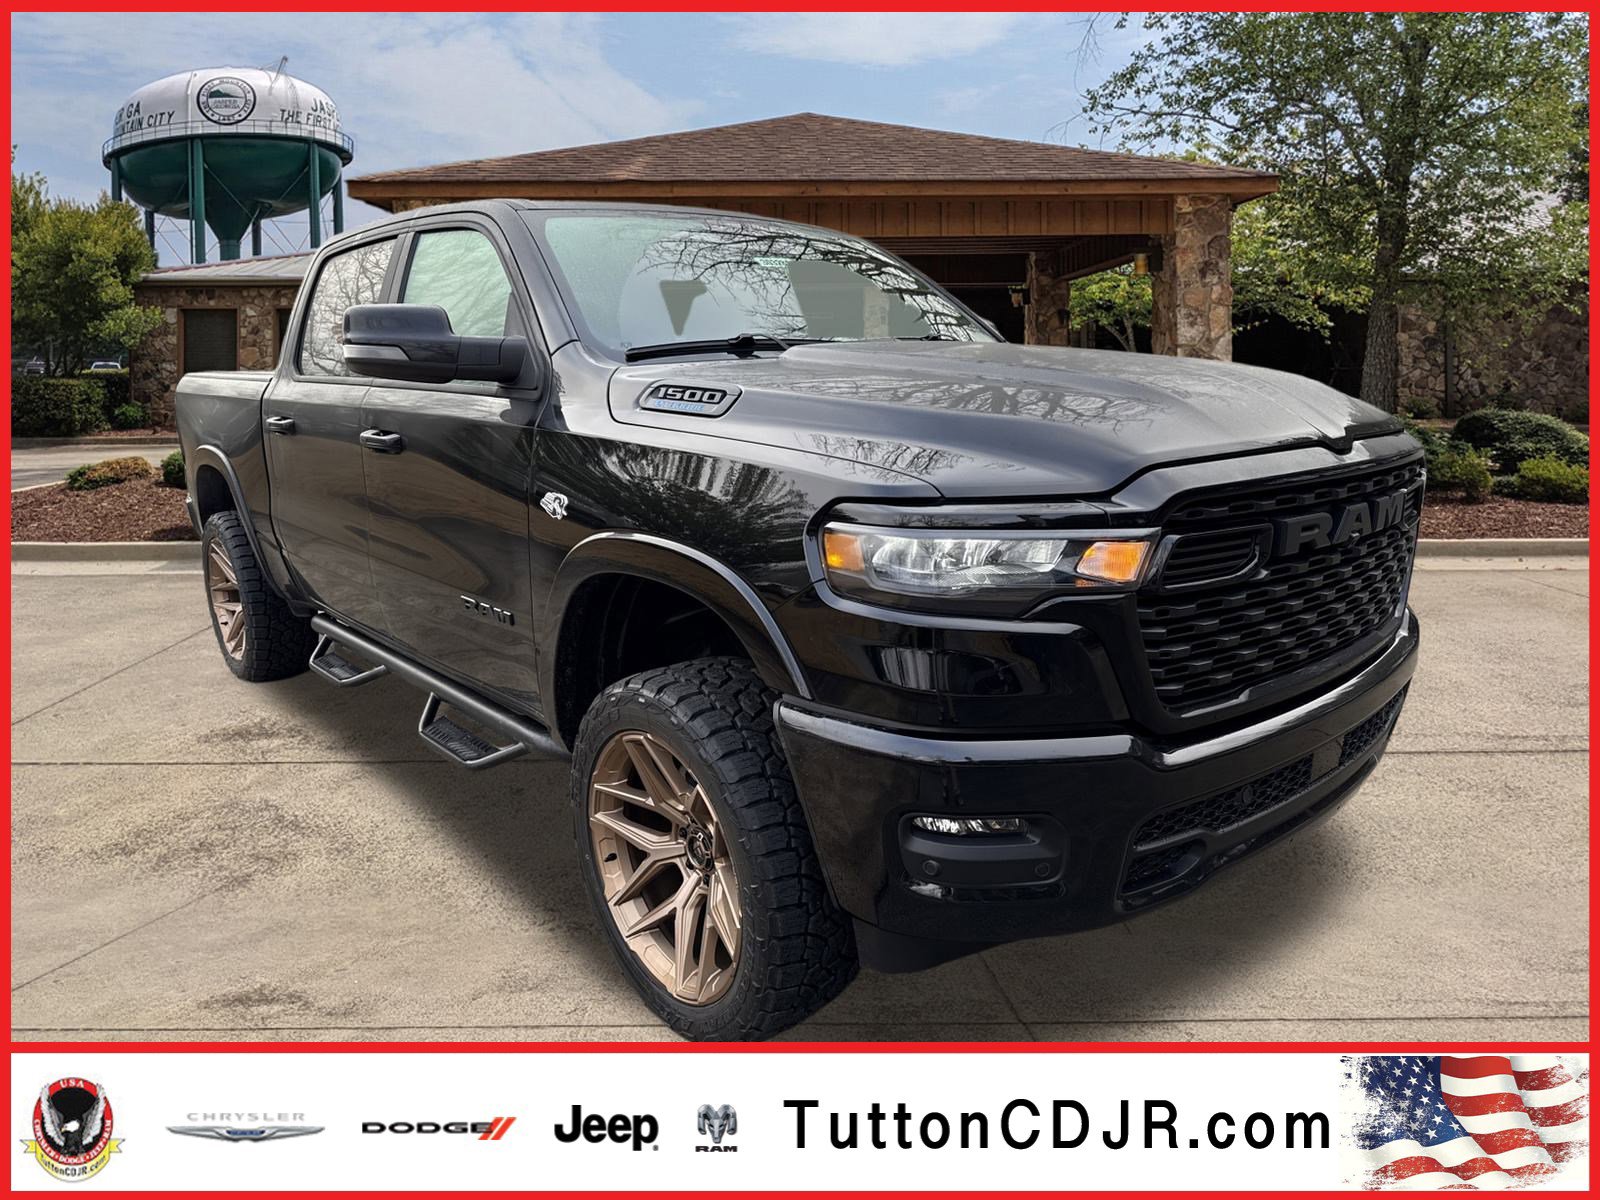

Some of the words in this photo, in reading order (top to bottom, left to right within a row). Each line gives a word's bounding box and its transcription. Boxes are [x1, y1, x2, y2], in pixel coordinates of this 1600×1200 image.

[126, 101, 141, 119] GA
[280, 108, 301, 125] THE
[147, 111, 175, 128] CITY
[658, 387, 722, 404] 1500
[1279, 490, 1405, 556] RAM
[461, 595, 515, 626] RAM
